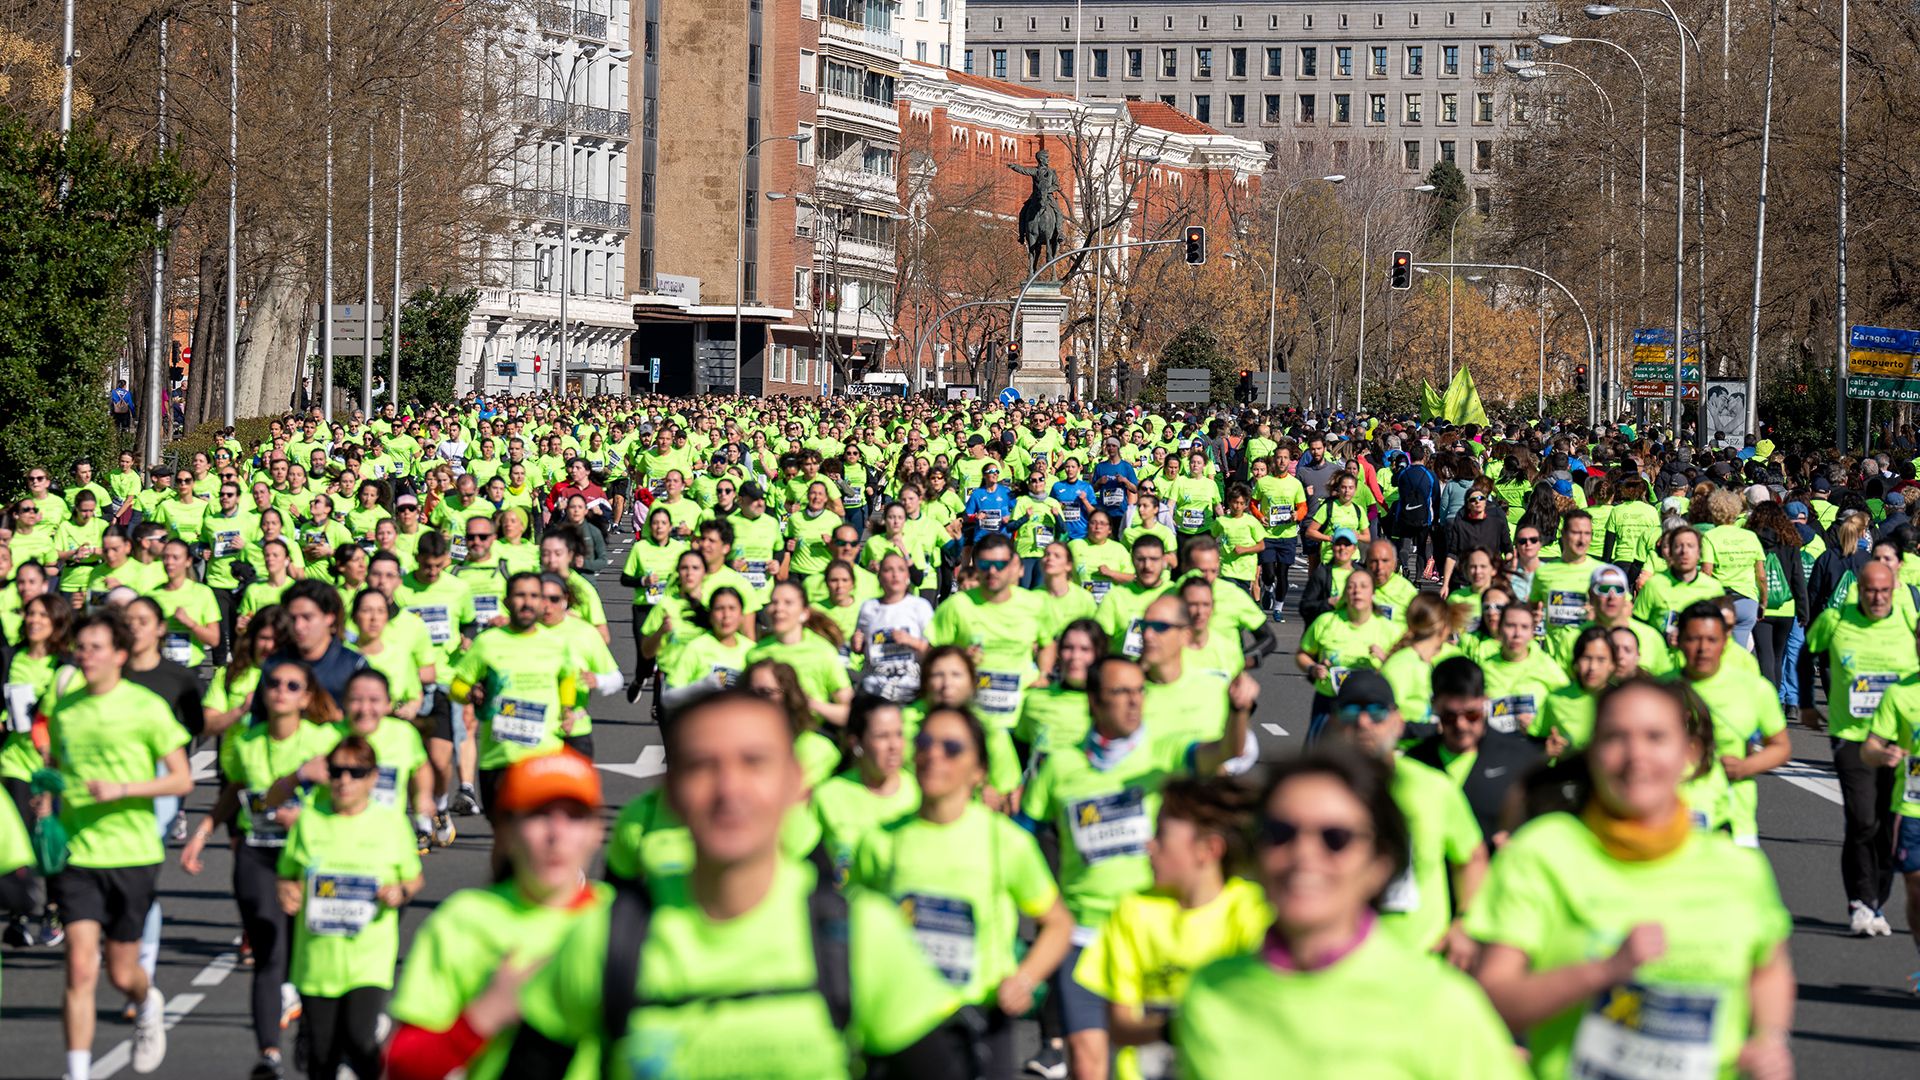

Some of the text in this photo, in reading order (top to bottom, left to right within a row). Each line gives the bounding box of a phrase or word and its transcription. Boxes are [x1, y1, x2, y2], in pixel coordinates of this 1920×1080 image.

[1853, 331, 1896, 344] Zaragoza
[1851, 358, 1904, 368] aeropuerto
[1878, 389, 1890, 397] de
[1892, 390, 1920, 399] Molin
